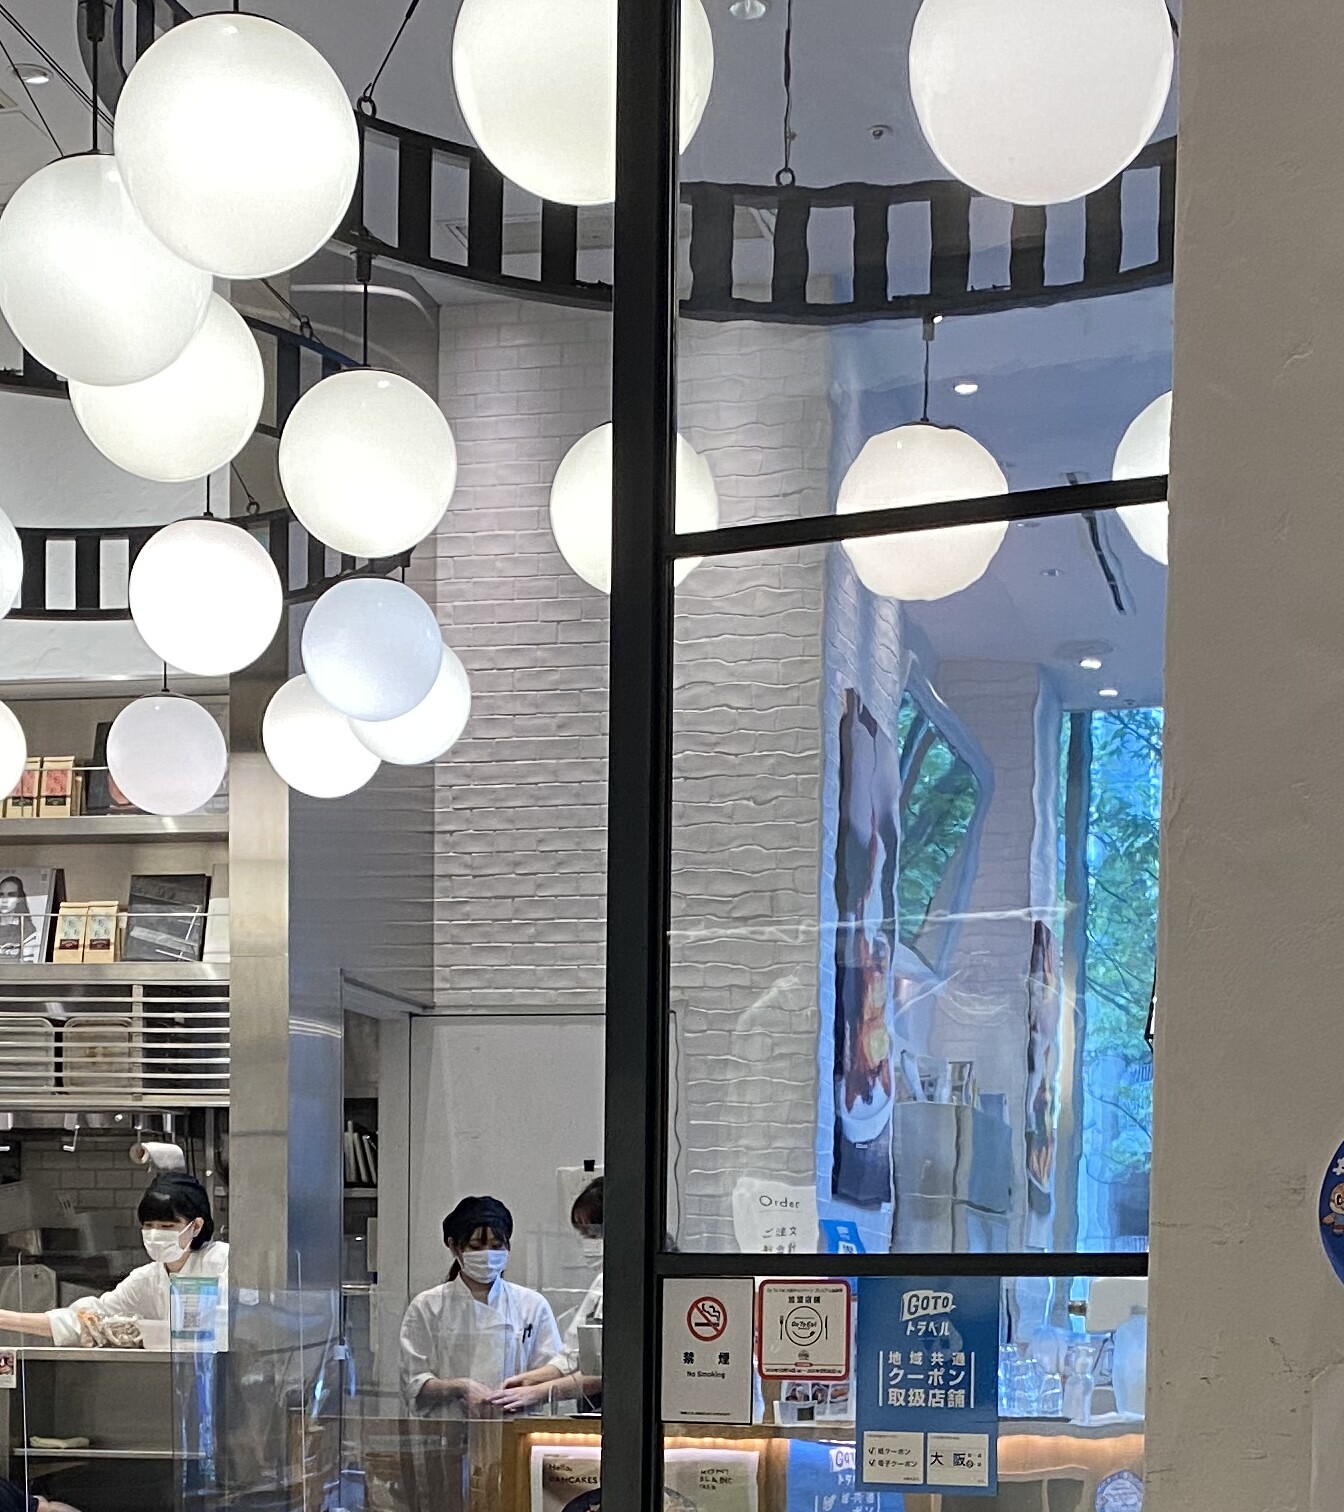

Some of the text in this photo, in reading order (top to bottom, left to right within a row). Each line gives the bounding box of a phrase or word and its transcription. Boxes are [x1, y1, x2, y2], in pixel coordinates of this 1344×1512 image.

[759, 1195, 800, 1209] Order
[906, 1321, 950, 1336] トラベル
[888, 1351, 965, 1366] 地域共通
[698, 1371, 725, 1379] Smoking
[889, 1368, 965, 1386] クーポン
[888, 1388, 965, 1408] 取扱店舗
